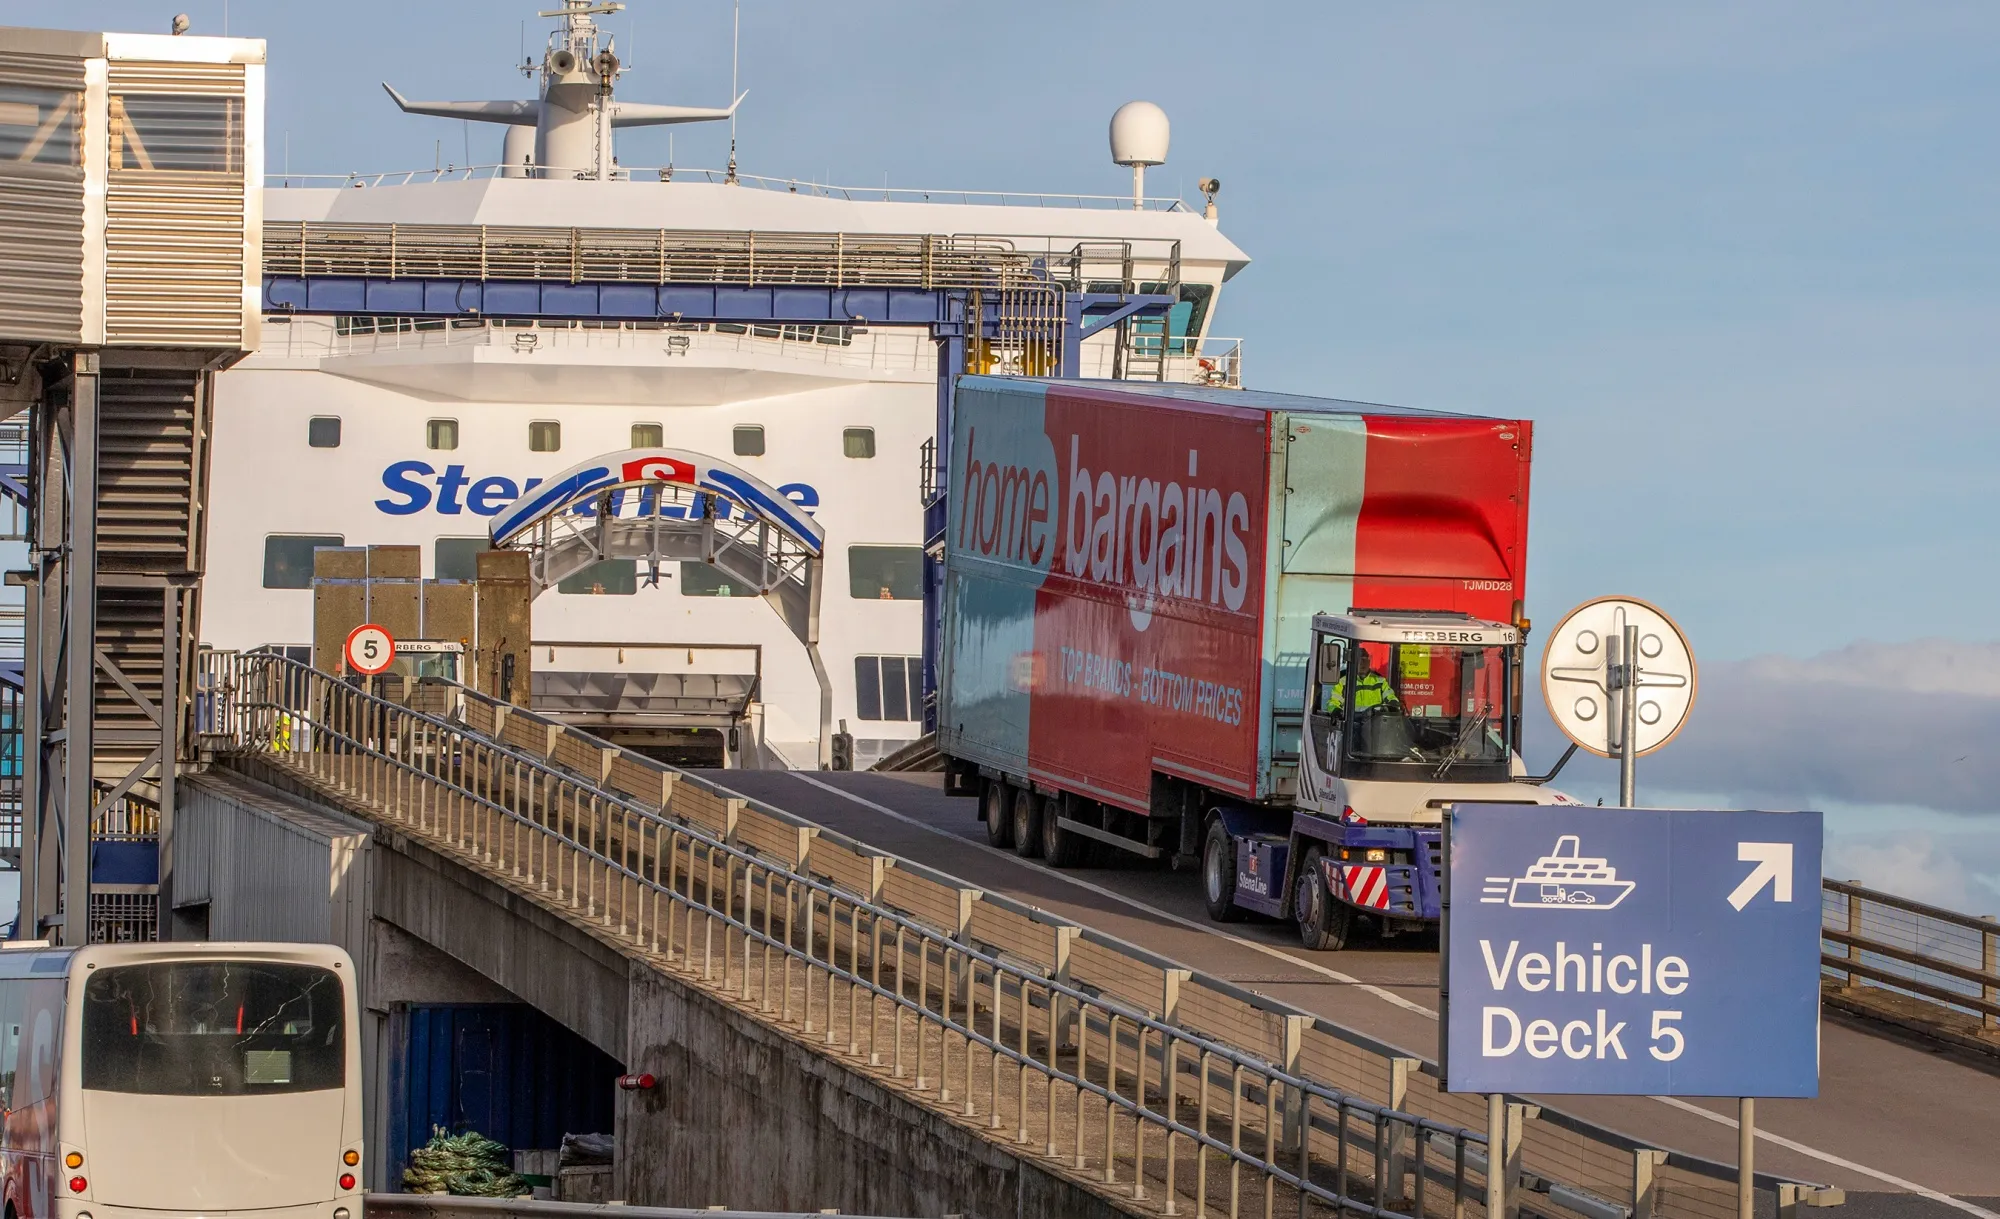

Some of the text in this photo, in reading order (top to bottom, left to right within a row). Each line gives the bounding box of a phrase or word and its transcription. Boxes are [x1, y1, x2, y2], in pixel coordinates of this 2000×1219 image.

[959, 426, 1250, 633] home bargains
[1463, 580, 1513, 591] TJMDD28
[364, 640, 378, 660] 5
[1401, 630, 1516, 642] TERBERG 161
[1060, 646, 1084, 684] TOP
[1084, 653, 1132, 698] BRANDS
[1140, 667, 1195, 713] BOTTOM
[1195, 679, 1243, 726] PRICES
[1479, 939, 1690, 996] Vehicle
[1481, 1006, 1686, 1062] Deck 5
